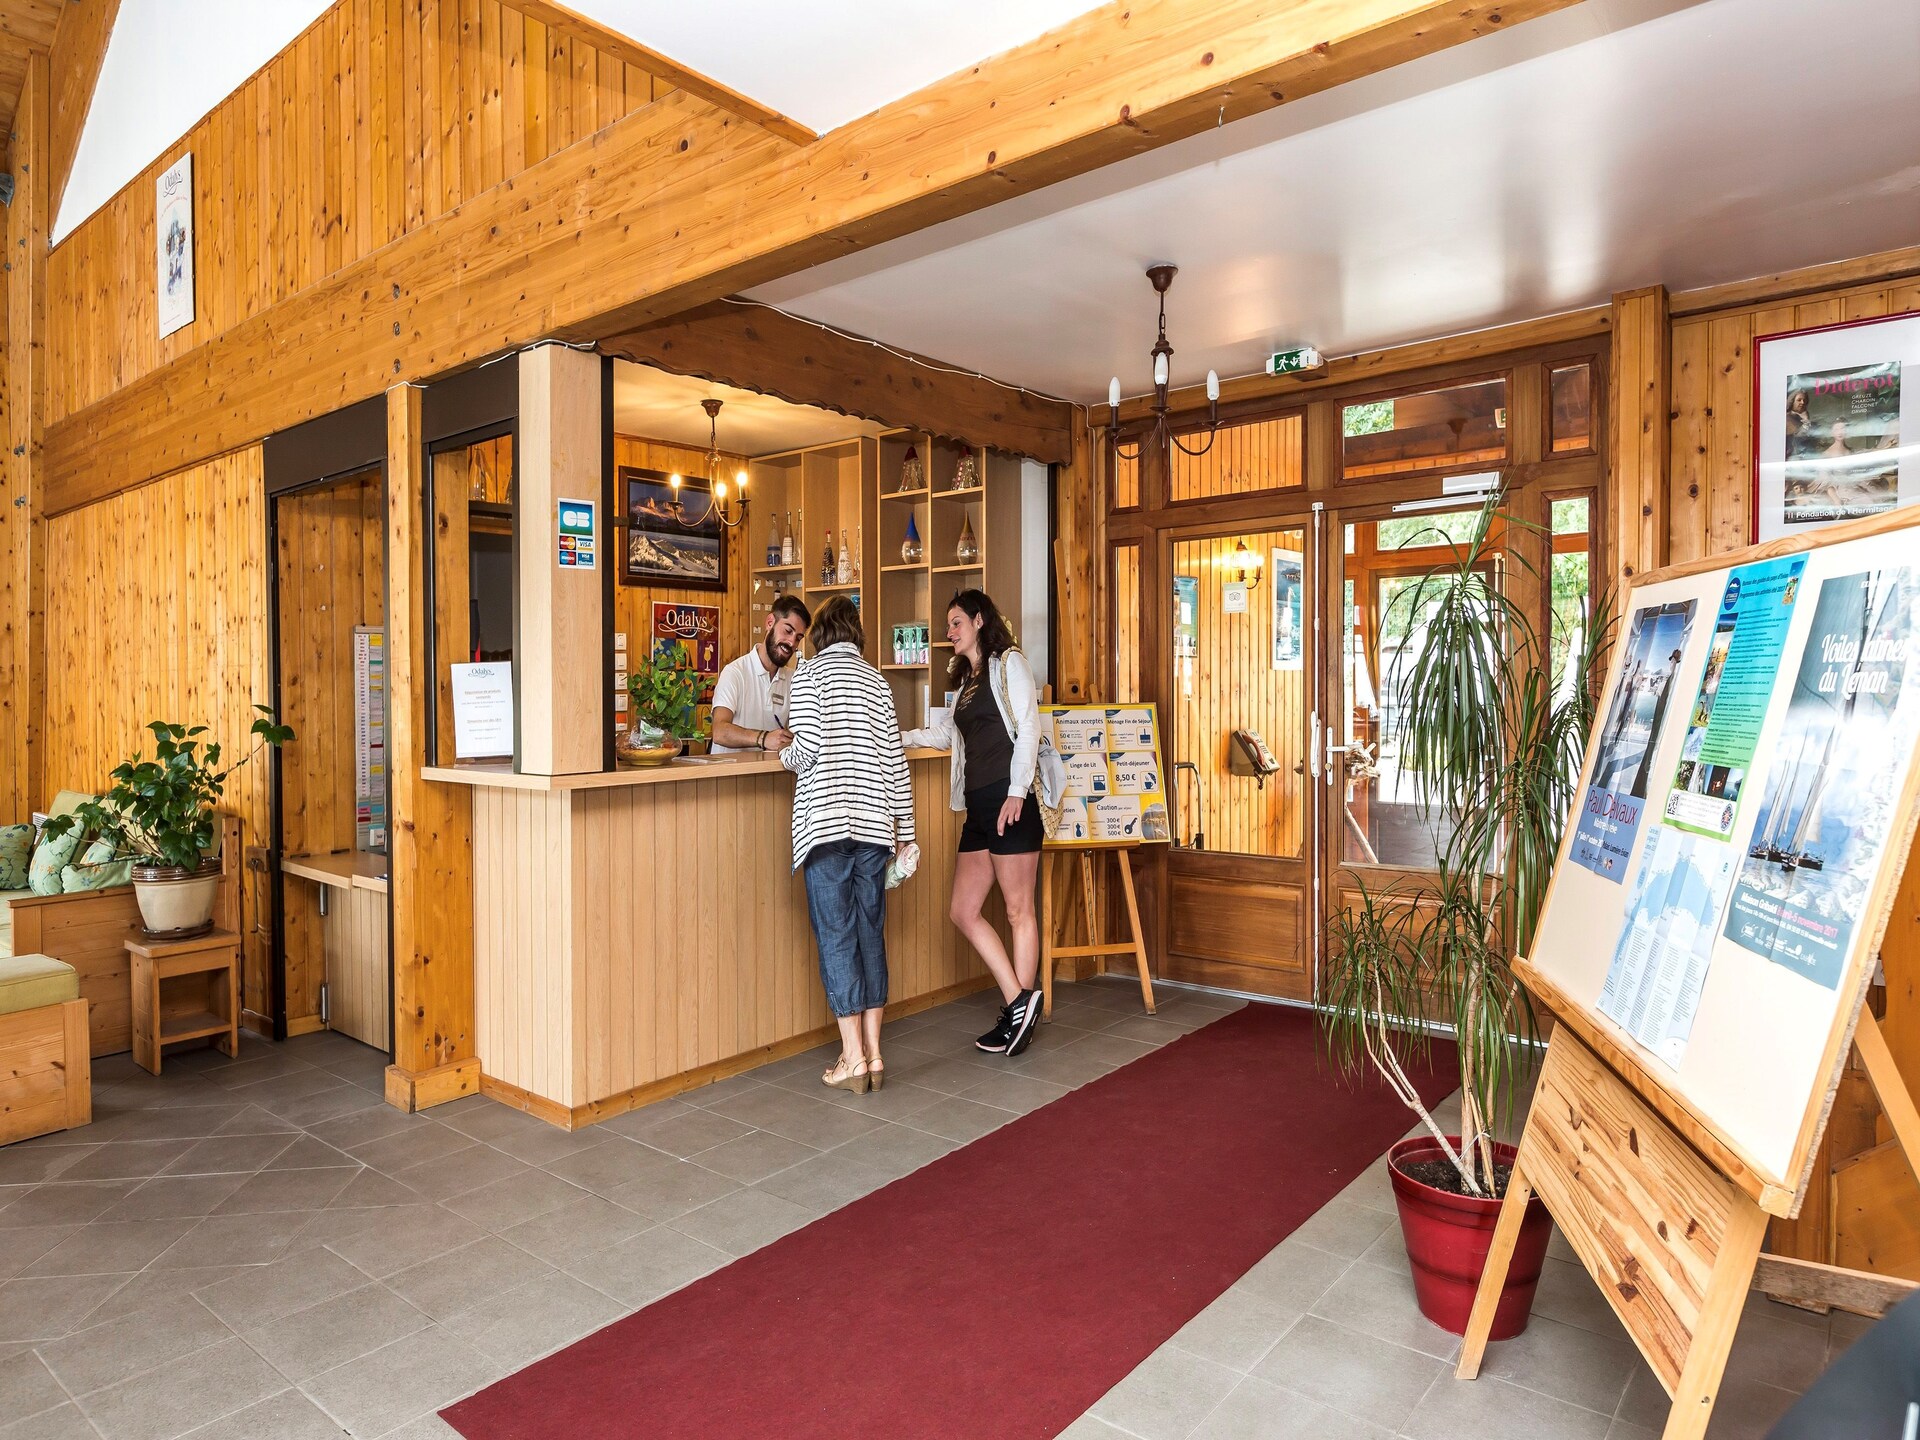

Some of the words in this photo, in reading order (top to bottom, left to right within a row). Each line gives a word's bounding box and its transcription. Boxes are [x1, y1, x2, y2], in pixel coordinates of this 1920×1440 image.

[1815, 374, 1894, 396] Diderot
[563, 511, 590, 527] CB
[1796, 509, 1834, 519] Fondation
[664, 609, 709, 633] Odalys
[1822, 633, 1860, 663] Voiles
[1862, 635, 1907, 662] latines
[470, 667, 493, 676] Odalys
[1819, 665, 1836, 692] du
[1116, 774, 1130, 782] 8,50
[1587, 789, 1604, 814] Paul
[1602, 794, 1638, 826] Delvaux
